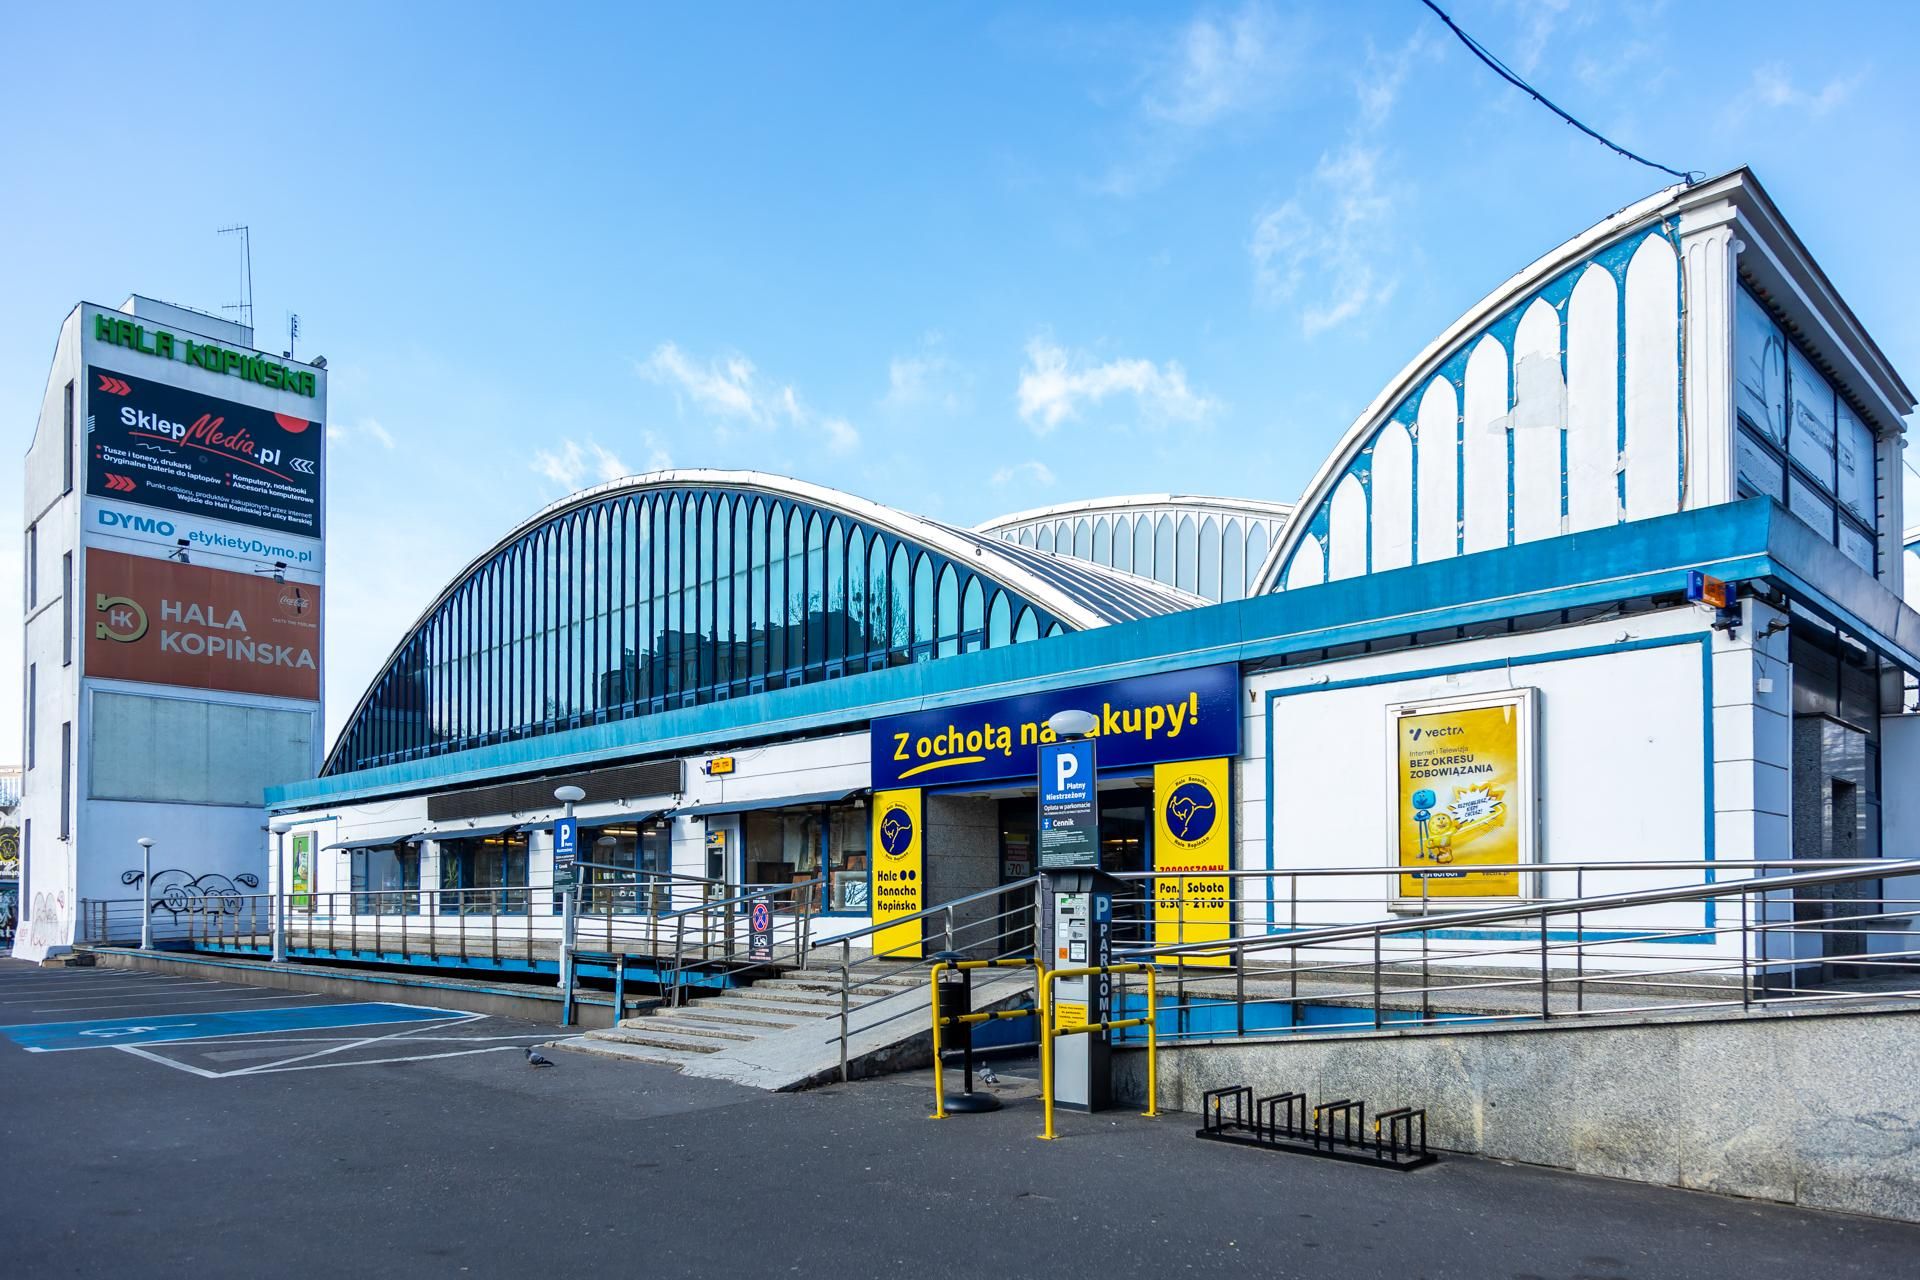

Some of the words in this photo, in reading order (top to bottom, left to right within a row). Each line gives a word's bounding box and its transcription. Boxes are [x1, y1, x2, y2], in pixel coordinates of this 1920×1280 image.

[96, 314, 174, 359] HALA
[186, 340, 316, 398] KOPIŃSKA
[103, 446, 126, 456] Tusze
[132, 451, 159, 464] tonery,
[160, 458, 192, 470] drukarki
[103, 454, 146, 468] Oryginalne
[148, 463, 175, 474] baterie
[176, 469, 186, 477] do
[188, 470, 221, 484] laptopów
[232, 474, 272, 488] Komputery,
[274, 483, 307, 494] notebooki
[233, 482, 268, 494] Akcesoria
[269, 489, 314, 503] komputerowe
[178, 494, 203, 504] Wejście
[231, 499, 269, 510] zakupionych
[99, 510, 175, 536] DYMO
[189, 530, 312, 562] etykietyDymo.pl
[161, 600, 247, 632] HALA
[161, 630, 316, 670] KOPIŃSKA
[894, 733, 910, 761] Z
[916, 723, 1012, 756] ochotą
[1021, 720, 1057, 745] na
[1083, 692, 1198, 740] akupy!
[1410, 759, 1429, 768] BEZ
[1431, 755, 1474, 766] OKRESU
[1057, 753, 1078, 791] P
[1410, 764, 1493, 778] ZOBOWIĄZANIA
[1066, 782, 1086, 790] Płatny
[1046, 791, 1086, 801] Niestrzeżony
[1053, 819, 1074, 827] Cennik
[561, 824, 570, 847] P
[878, 870, 897, 881] Hale
[878, 885, 916, 896] Banacha
[1160, 883, 1179, 893] Pon.
[1188, 882, 1224, 892] Sobota
[878, 900, 916, 912] Kopińska
[1096, 897, 1108, 920] P
[1194, 898, 1224, 908] 21.00
